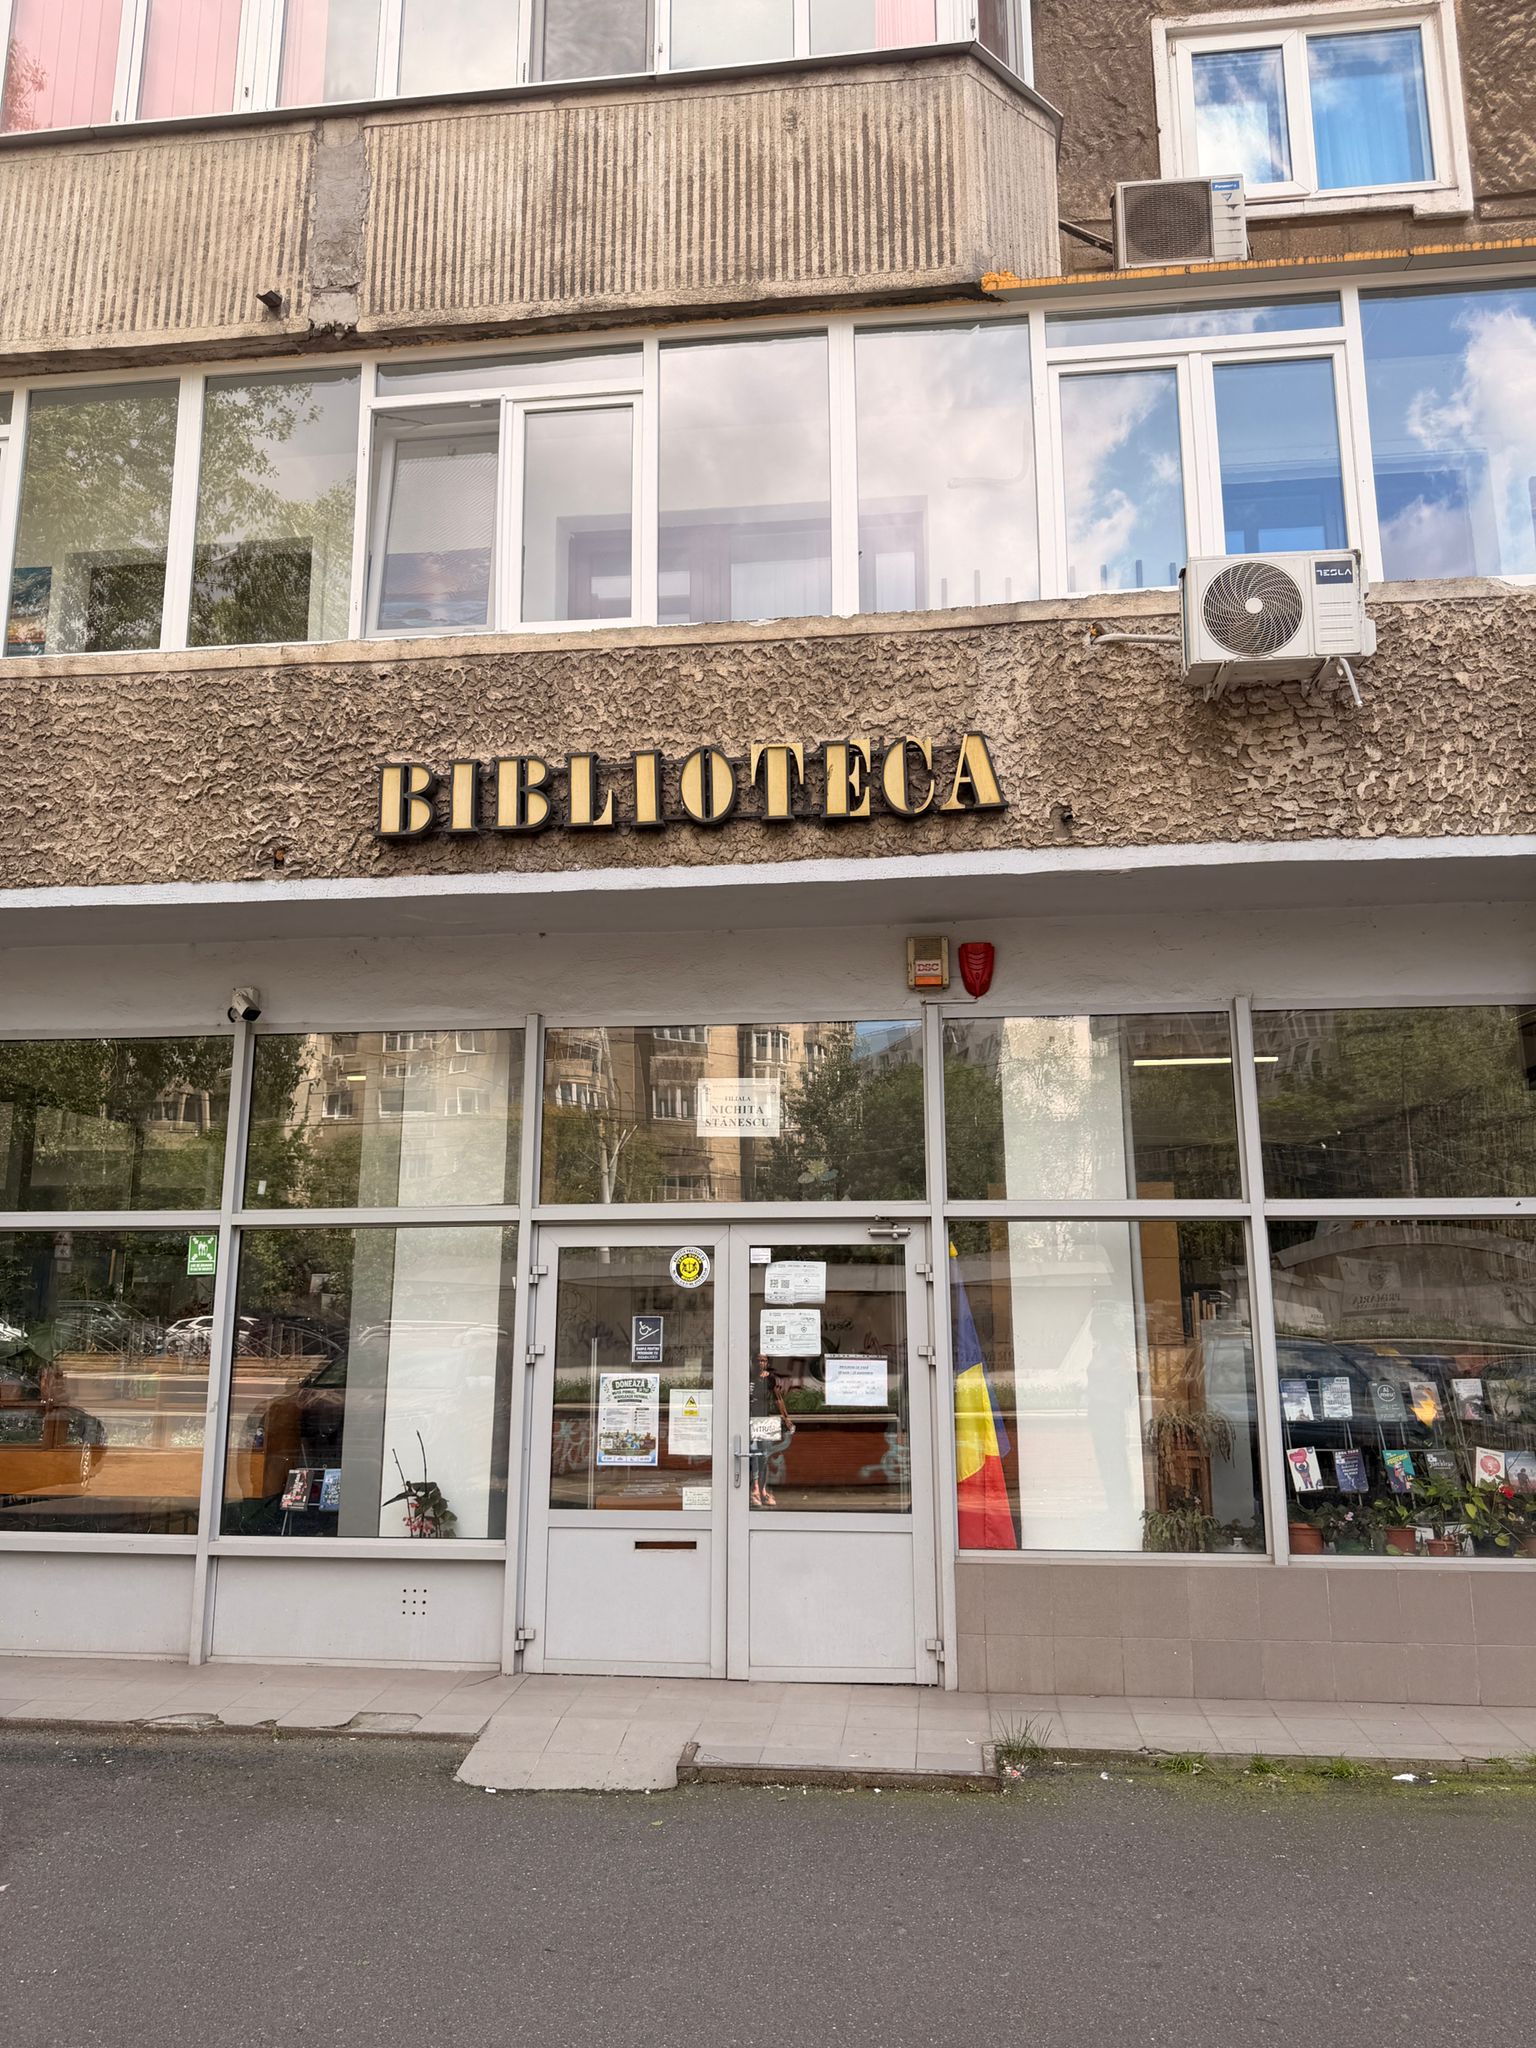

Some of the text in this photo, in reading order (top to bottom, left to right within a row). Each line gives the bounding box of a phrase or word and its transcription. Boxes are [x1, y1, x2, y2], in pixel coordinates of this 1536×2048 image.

[375, 731, 1008, 839] BIBLIOTECA
[917, 963, 939, 972] DSC
[712, 1105, 764, 1115] NICHITA
[704, 1117, 770, 1127] STĂNESCU
